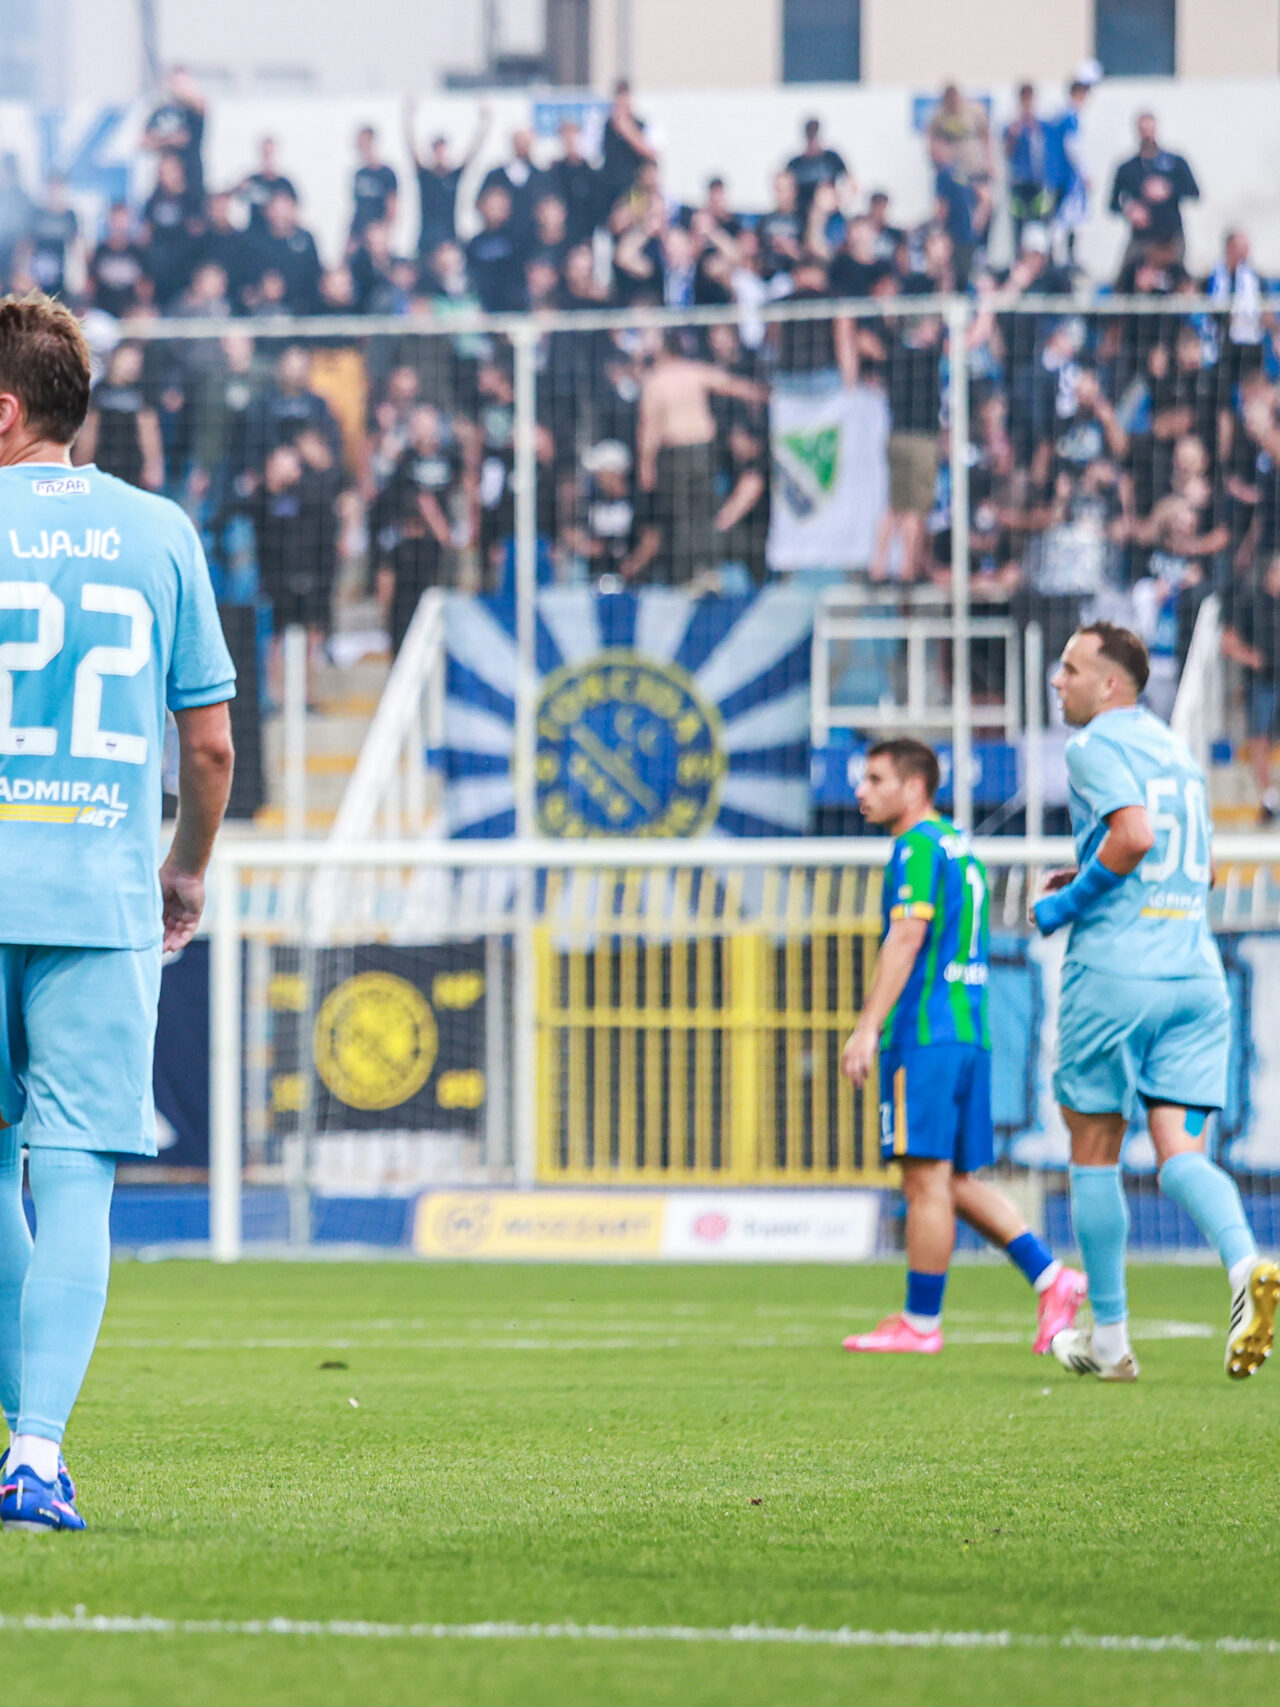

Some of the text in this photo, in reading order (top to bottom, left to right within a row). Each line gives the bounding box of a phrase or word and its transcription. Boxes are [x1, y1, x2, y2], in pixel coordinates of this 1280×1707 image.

[8, 528, 121, 561] LJAJIĆ
[77, 806, 128, 829] BET
[1140, 777, 1210, 884] 50
